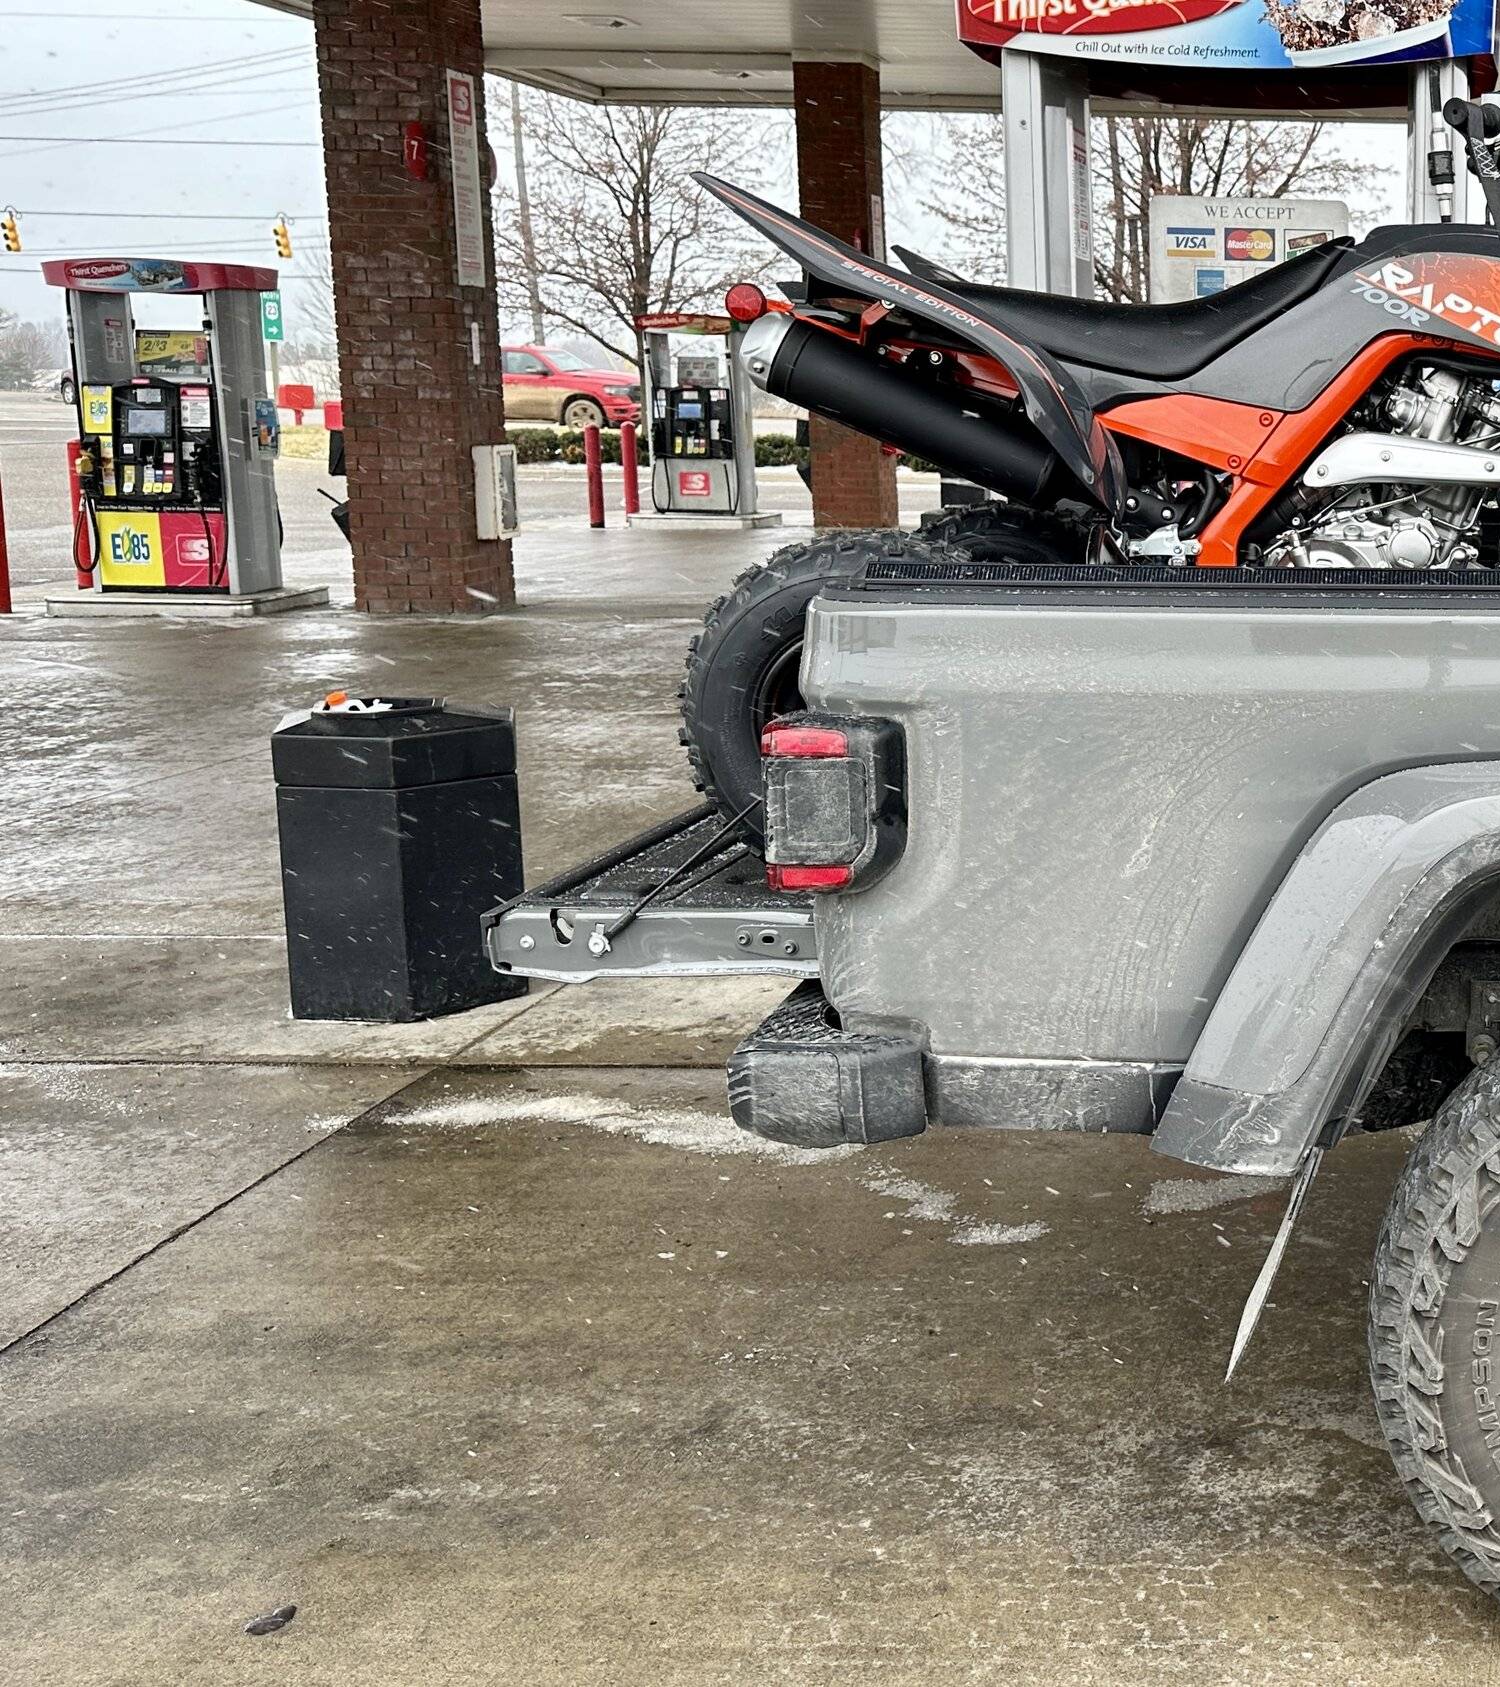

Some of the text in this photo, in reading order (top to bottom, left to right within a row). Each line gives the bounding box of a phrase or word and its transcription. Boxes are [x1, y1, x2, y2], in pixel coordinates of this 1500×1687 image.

[1075, 42, 1261, 60] Chill Out with Ice Cold Refreshment.
[410, 140, 418, 160] 7
[1204, 205, 1296, 220] WE ACCEPT
[1174, 236, 1207, 249] VISA
[1227, 239, 1274, 250] MasterCard
[841, 260, 980, 328] SPECIAL EDITION
[1350, 278, 1431, 327] 700R
